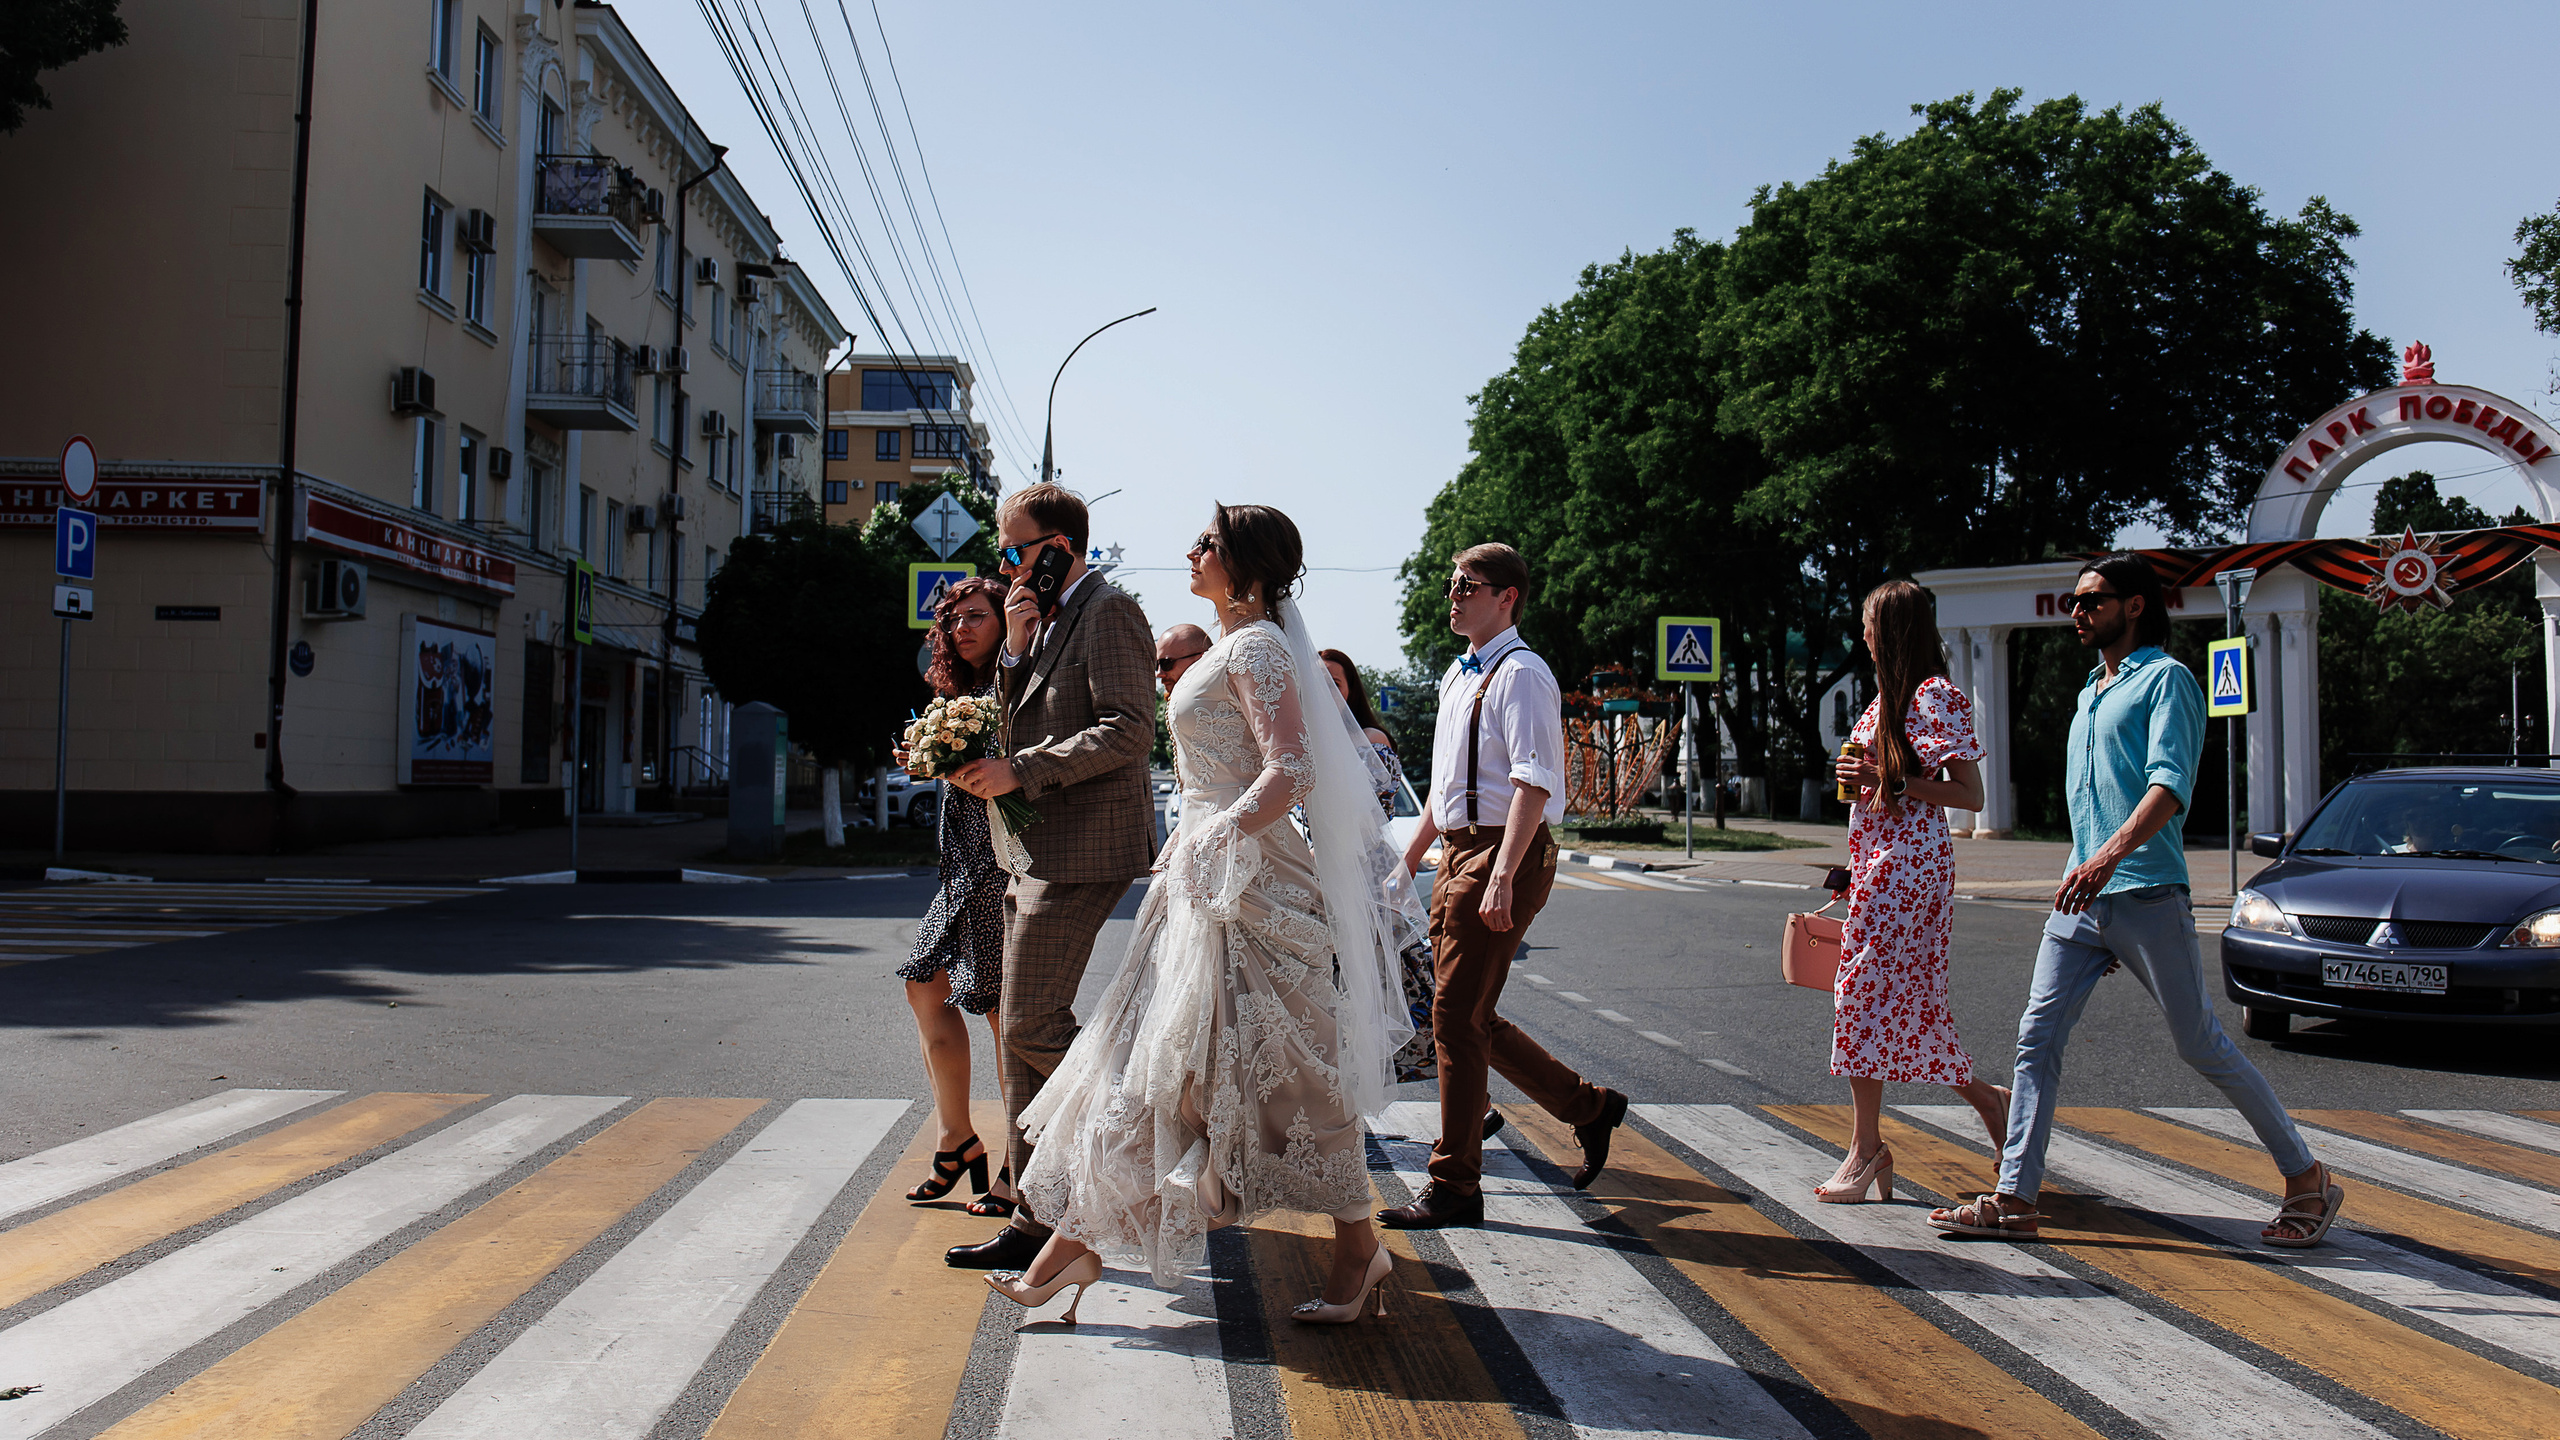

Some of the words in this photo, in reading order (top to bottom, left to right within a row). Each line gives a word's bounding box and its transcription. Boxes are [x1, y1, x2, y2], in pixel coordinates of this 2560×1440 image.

[2283, 406, 2376, 484] ПАРК
[2398, 395, 2552, 467] ПОБЕДЫ
[0, 488, 244, 511] НЦМАРКЕТ
[0, 514, 37, 523] ЕБА.
[112, 516, 214, 526] ТВОРЧЕСТВО.
[384, 527, 492, 573] КАНЦМАРКЕТ
